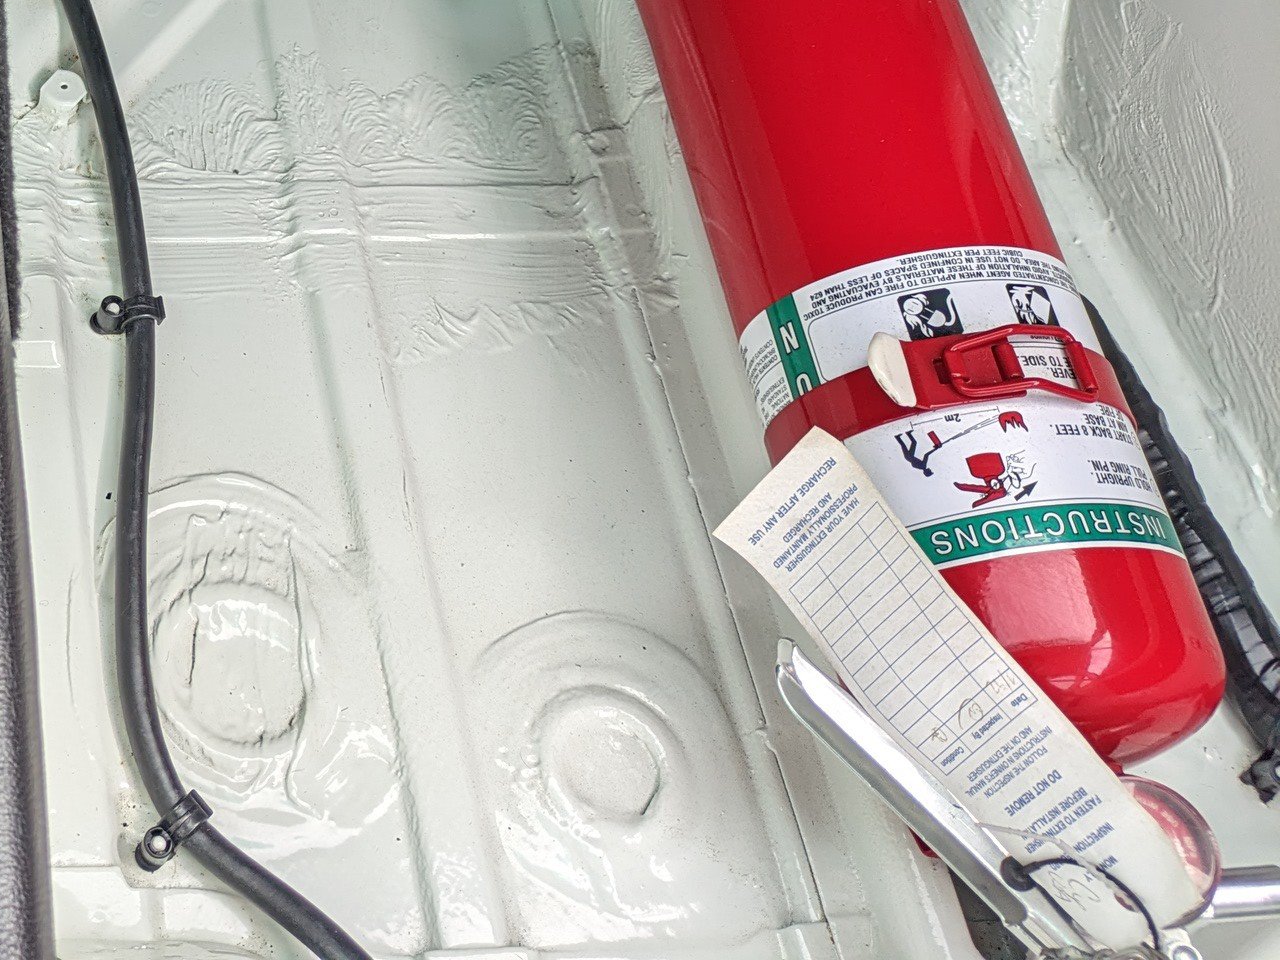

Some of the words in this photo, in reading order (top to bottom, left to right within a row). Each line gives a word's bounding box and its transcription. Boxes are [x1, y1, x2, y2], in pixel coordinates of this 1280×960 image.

[895, 249, 961, 265] EXTINGUISHER.
[963, 248, 979, 256] PER
[975, 255, 991, 263] USE
[1001, 249, 1023, 257] CUBIC
[883, 263, 918, 276] SPACES
[919, 256, 962, 269] CONFINED
[945, 262, 973, 273] THESE
[987, 263, 1030, 272] INHALATION
[846, 275, 868, 287] LESS
[871, 271, 882, 280] OF
[881, 276, 893, 285] BY
[895, 266, 944, 281] MATERIALS
[919, 272, 955, 284] APPLIED
[959, 271, 983, 279] WHEN
[1012, 271, 1060, 285] CONCENTRATED
[823, 282, 844, 295] THAN
[827, 280, 879, 301] EVACUATING
[884, 282, 904, 292] FIRE
[905, 279, 917, 287] TO
[864, 286, 883, 298] CAN
[811, 296, 826, 309] AND
[825, 293, 861, 310] PRODUCE
[802, 306, 824, 320] TOXIC
[1016, 355, 1047, 366] SIDE.
[1048, 355, 1063, 366] TO
[1046, 367, 1076, 378] EVER.
[943, 412, 961, 422] 2m
[1082, 413, 1106, 426] BASE
[1106, 416, 1116, 428] AT
[1049, 424, 1080, 435] FEET.
[1080, 425, 1088, 435] 8
[1088, 425, 1113, 438] BACK
[1112, 429, 1133, 444] START
[1087, 459, 1108, 470] PIN.
[1109, 460, 1131, 475] RING
[1129, 465, 1146, 479] PULL
[796, 456, 837, 497] RECHARGE
[1090, 471, 1134, 486] UPRIGHT.
[1135, 477, 1152, 492] HOLD
[774, 493, 799, 518] AFTER
[816, 492, 832, 508] AND
[840, 497, 860, 516] HAVE
[805, 482, 858, 536] PROFESSIONALLY
[760, 514, 778, 533] ANY
[781, 505, 820, 543] RECHARGED
[824, 513, 844, 533] YOUR
[747, 528, 765, 546] USE
[930, 509, 1167, 555] INSTRUCTIONS
[771, 532, 809, 569] MAINTAINED
[784, 529, 827, 572] EXTINGUISHER
[1009, 692, 1028, 708] Date
[977, 712, 1004, 735] Inspected
[970, 731, 982, 740] By
[1017, 724, 1032, 739] AND
[1009, 734, 1021, 745] ON
[1011, 725, 1052, 760] INSTRUCTIONS
[999, 742, 1014, 754] THE
[939, 745, 965, 767] Condition
[1005, 755, 1015, 765] IN
[1021, 745, 1048, 768] FOLLOW
[966, 749, 1004, 782] EXTINGUISHER
[983, 760, 1009, 782] OWNER'S
[1010, 763, 1025, 776] THE
[982, 770, 1015, 798] INSPECTION
[1045, 769, 1063, 784] DO
[964, 778, 987, 796] MANUAL
[1031, 777, 1051, 796] NOT
[1003, 789, 1036, 817] REMOVE
[1057, 786, 1088, 811] BEFORE
[1072, 794, 1103, 818] FASTEN
[1020, 806, 1061, 840] INSTALLATN
[1062, 814, 1077, 826] TO
[1072, 821, 1115, 853] INSPECTION
